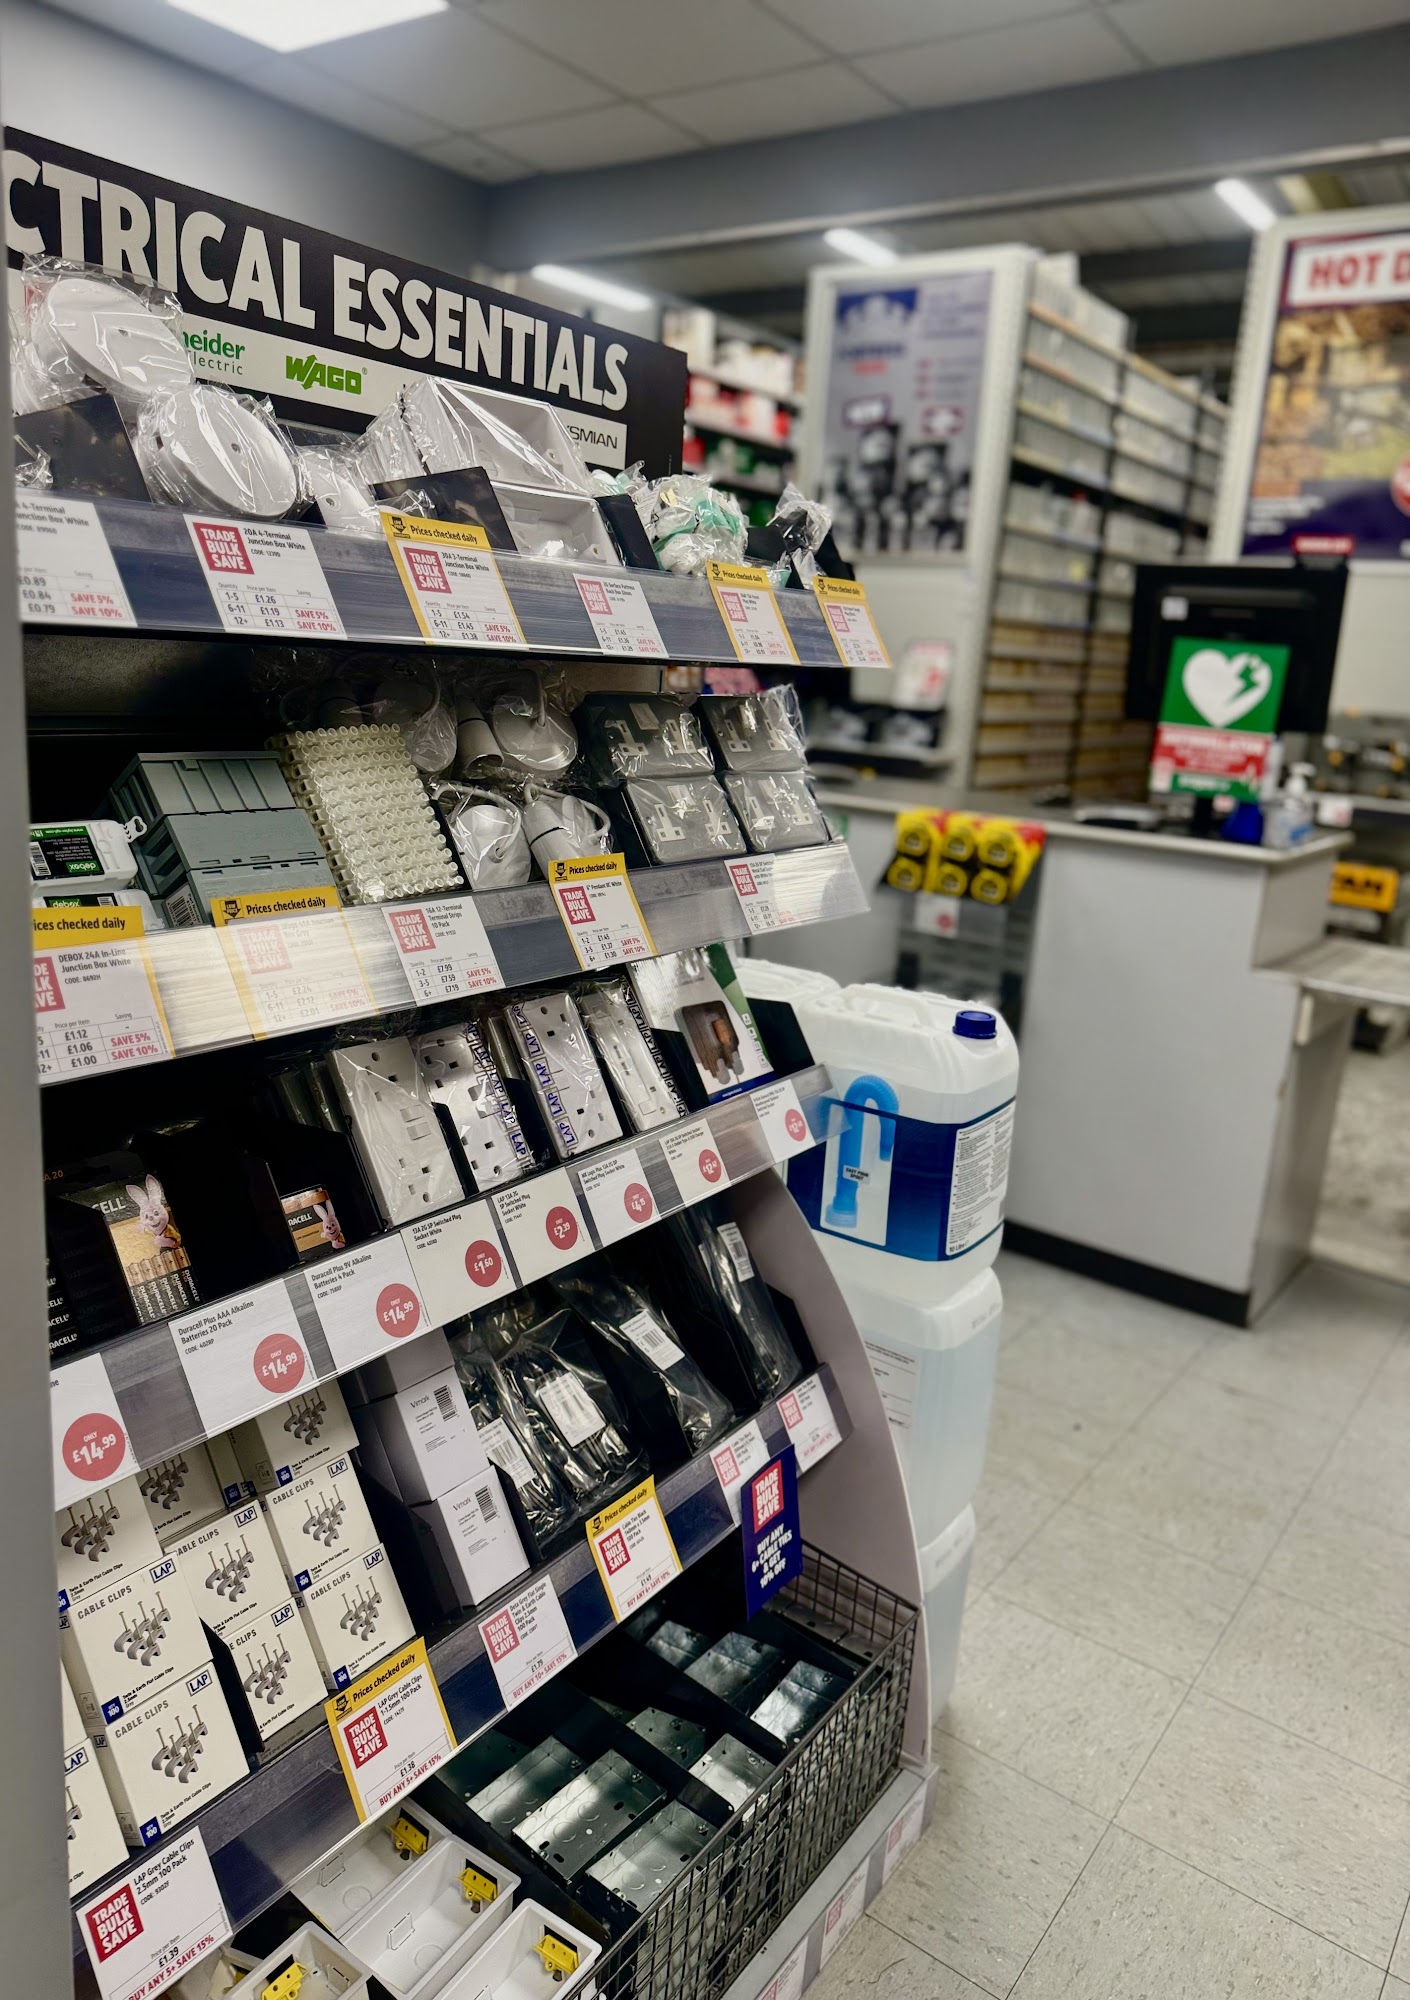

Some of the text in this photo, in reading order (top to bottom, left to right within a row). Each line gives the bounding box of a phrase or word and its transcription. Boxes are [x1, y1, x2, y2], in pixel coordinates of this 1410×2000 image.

[1309, 252, 1382, 287] HOT
[333, 254, 628, 411] ESSENTIALS
[286, 355, 362, 395] WAGO
[567, 425, 617, 449] SMIAN
[201, 528, 237, 543] TRADE
[410, 525, 478, 544] Prices checked daily
[206, 540, 242, 556] BULK
[212, 554, 247, 570] SAVE
[722, 569, 763, 583] Prices checked daily
[22, 590, 114, 605] £0.84 SAVE 5%
[28, 603, 122, 618] £0.79 SAVE 10%
[434, 619, 448, 628] 6-11
[458, 622, 474, 630] £1.45
[484, 624, 500, 632] SAVE
[569, 862, 617, 874] Prices checked daily
[246, 897, 326, 915] Prices checked daily
[398, 923, 426, 937] BULK
[403, 935, 430, 949] SAVE
[61, 958, 131, 973] Junction Box White
[468, 980, 482, 988] SAVE
[483, 976, 496, 985] 10%
[67, 1032, 151, 1055] £1.06 SAVE 5%
[525, 1033, 541, 1054] LAP
[71, 1044, 158, 1068] £1.00 SAVE 10%
[535, 1063, 552, 1085] LAP
[548, 1093, 563, 1115] LAP
[511, 1133, 526, 1155] LAP
[559, 1122, 575, 1144] LAP
[502, 1202, 527, 1217] Socket White
[414, 1227, 442, 1242] Socket White
[554, 1222, 570, 1239] £2.39
[311, 1253, 372, 1282] Duracell Plus 9V Alkaline
[474, 1257, 493, 1274] £1.60
[314, 1269, 356, 1290] Batteries 4 Pack
[139, 1285, 156, 1318] DURACELL
[383, 1301, 414, 1324] £14.99
[178, 1300, 254, 1336] Duracell Plus AAA Alkaline
[181, 1319, 233, 1344] Batteries 20 Pack
[262, 1352, 297, 1379] £14.99
[410, 1394, 430, 1409] Vimark
[83, 1431, 98, 1442] ONLY
[72, 1433, 117, 1465] £14.99
[280, 1472, 290, 1481] 100
[330, 1461, 345, 1475] LAP
[272, 1478, 315, 1505] CABLE CLIPS
[755, 1467, 779, 1496] TRADE
[453, 1497, 472, 1511] Vimark
[604, 1488, 648, 1523] Prices checked daily
[756, 1482, 779, 1510] BULK
[237, 1509, 254, 1524] LAP
[757, 1499, 780, 1527] SAVE
[757, 1523, 784, 1555] BUY ANY
[366, 1552, 380, 1566] LAP
[752, 1529, 792, 1573] 6+ CABLE TIES
[763, 1550, 781, 1573] & GET
[153, 1562, 172, 1580] LAP
[299, 1576, 309, 1585] 100
[760, 1558, 786, 1588] 10% OFF
[310, 1572, 351, 1600] CABLE CLIPS
[510, 1602, 519, 1611] Deta
[520, 1596, 528, 1605] Grey
[535, 1582, 547, 1593] Single
[77, 1585, 133, 1619] CABLE CLIPS
[512, 1591, 546, 1618] Twin Earth Cable
[274, 1606, 291, 1625] LAP
[235, 1629, 257, 1652] CLIPS
[189, 1674, 208, 1692] LAP
[338, 1674, 347, 1682] 100
[353, 1653, 416, 1702] Prices checked daily
[513, 1652, 567, 1698] BUY ANY 10+ SAVE 15%
[108, 1707, 120, 1717] 100
[115, 1700, 169, 1739] CABLE CLIPS
[349, 1713, 375, 1737] TRADE
[353, 1724, 379, 1748] BULK
[145, 1827, 158, 1838] 100
[133, 1839, 195, 1886] LAP Grey Cable Clips
[137, 1855, 188, 1895] 2.5mm 100 Pack
[92, 1892, 129, 1925] TRADE
